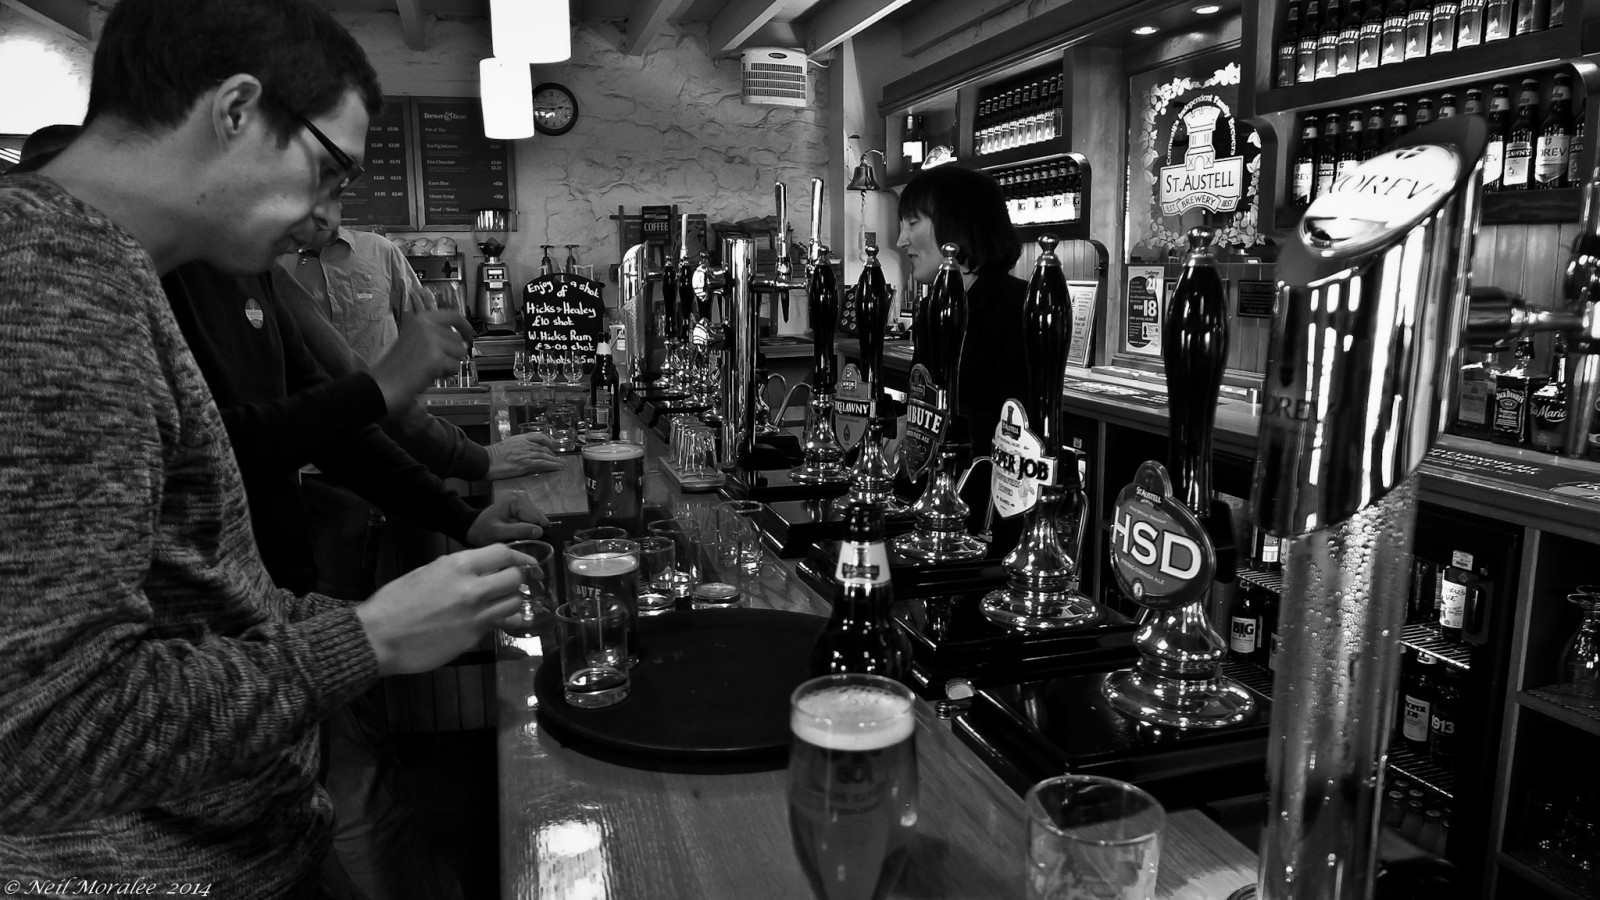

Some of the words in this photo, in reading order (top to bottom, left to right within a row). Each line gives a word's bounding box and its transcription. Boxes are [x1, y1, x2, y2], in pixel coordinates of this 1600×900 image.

[1182, 194, 1216, 208] BREWERY
[644, 222, 668, 232] COFFEE
[527, 281, 553, 294] Enjoy
[579, 282, 599, 298] shot
[557, 285, 568, 297] of
[527, 302, 555, 314] Hicks
[563, 301, 596, 318] Healey
[1144, 300, 1157, 317] 18
[532, 315, 549, 326] £10
[553, 316, 574, 326] shot
[570, 330, 592, 341] Rum
[571, 342, 596, 351] shot
[1017, 456, 1049, 481] JOB
[1112, 506, 1202, 579] HSD
[1233, 621, 1254, 635] BIG
[1431, 714, 1455, 734] 1913
